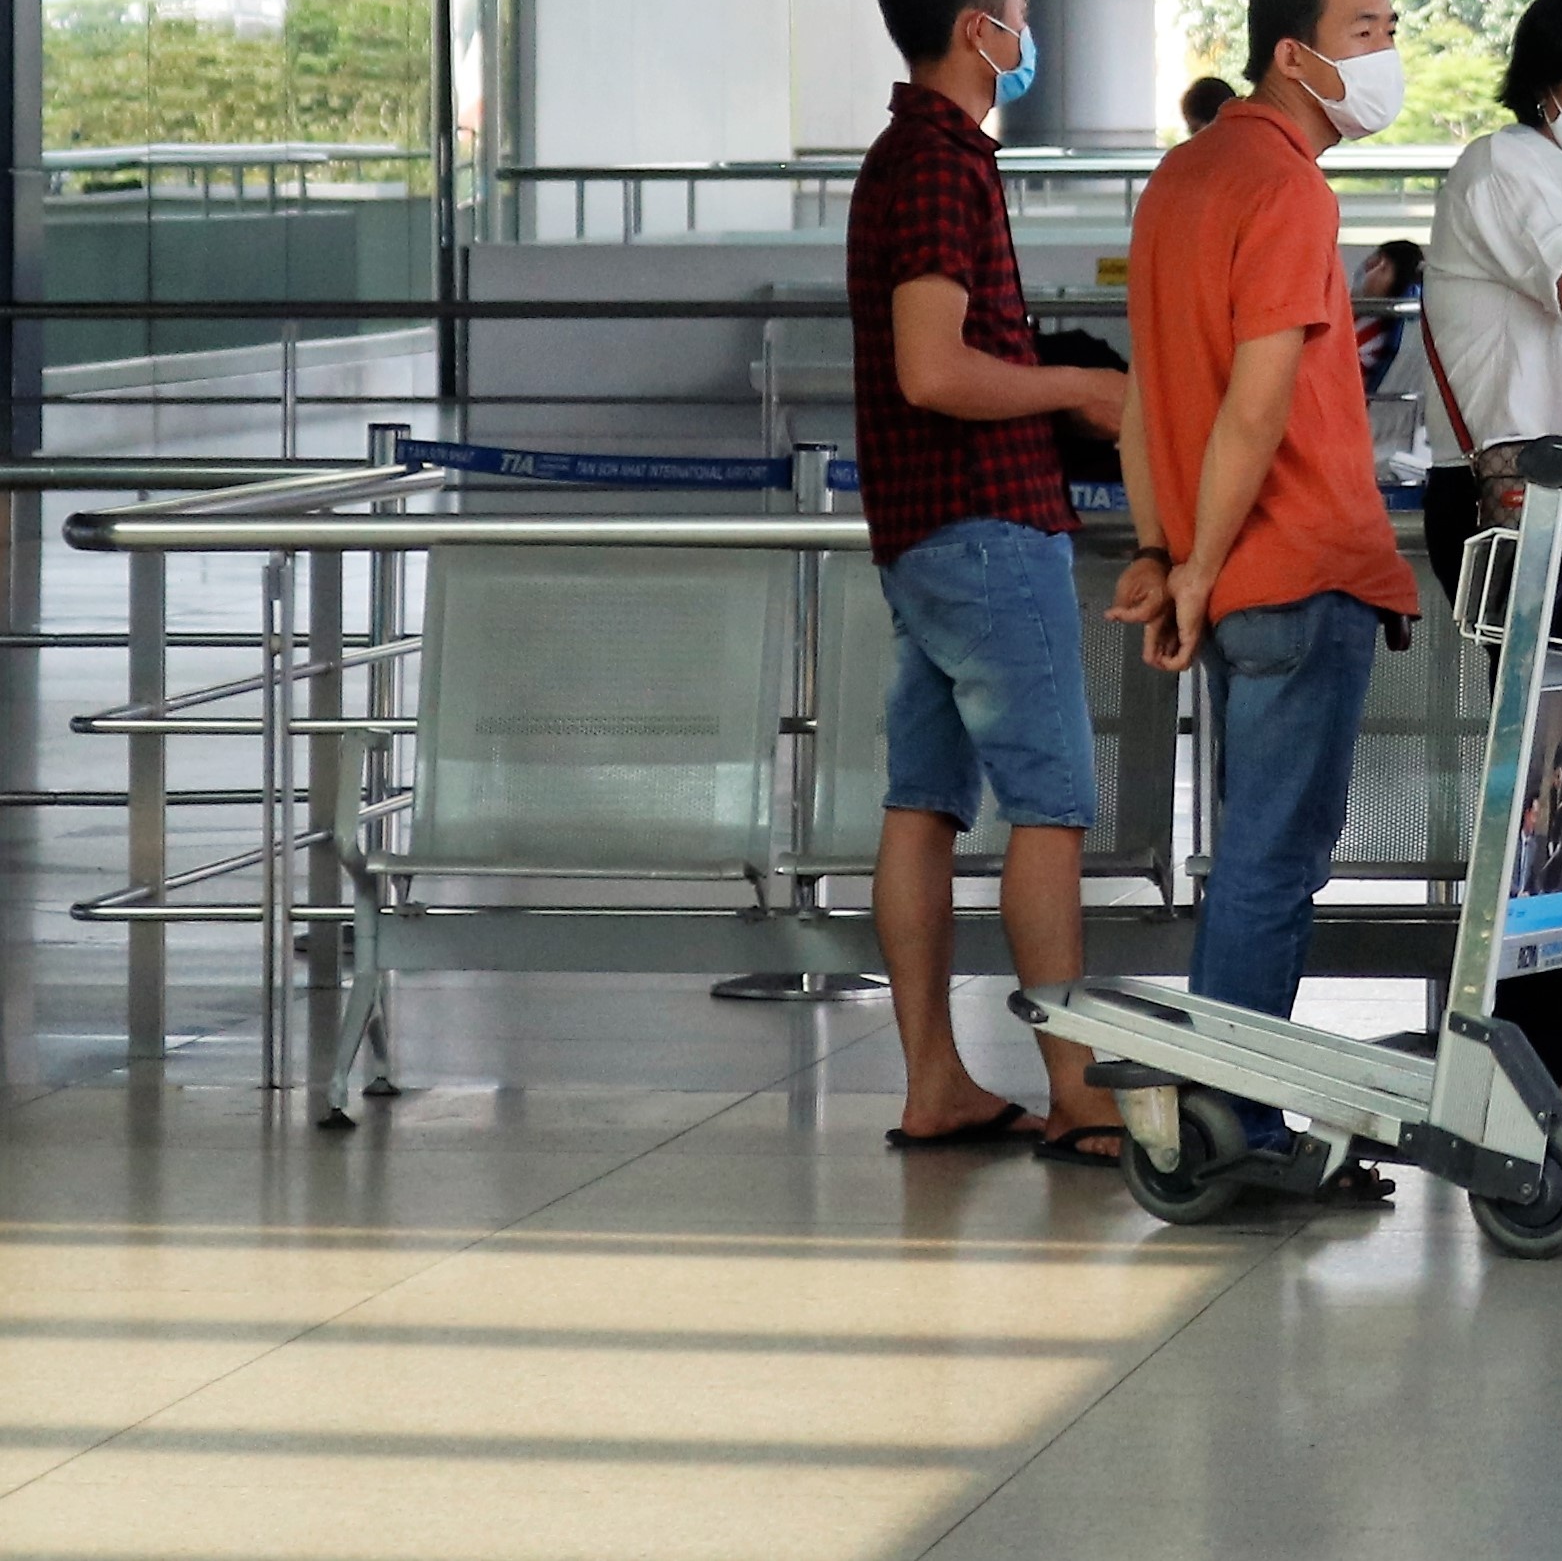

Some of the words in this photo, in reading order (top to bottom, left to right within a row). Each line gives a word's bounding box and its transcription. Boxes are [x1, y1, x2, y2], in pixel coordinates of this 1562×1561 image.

[500, 453, 535, 475] TIA
[648, 464, 723, 480] INTERNATIONAL
[725, 465, 769, 481] AIRPORT
[1070, 487, 1111, 507] TIA
